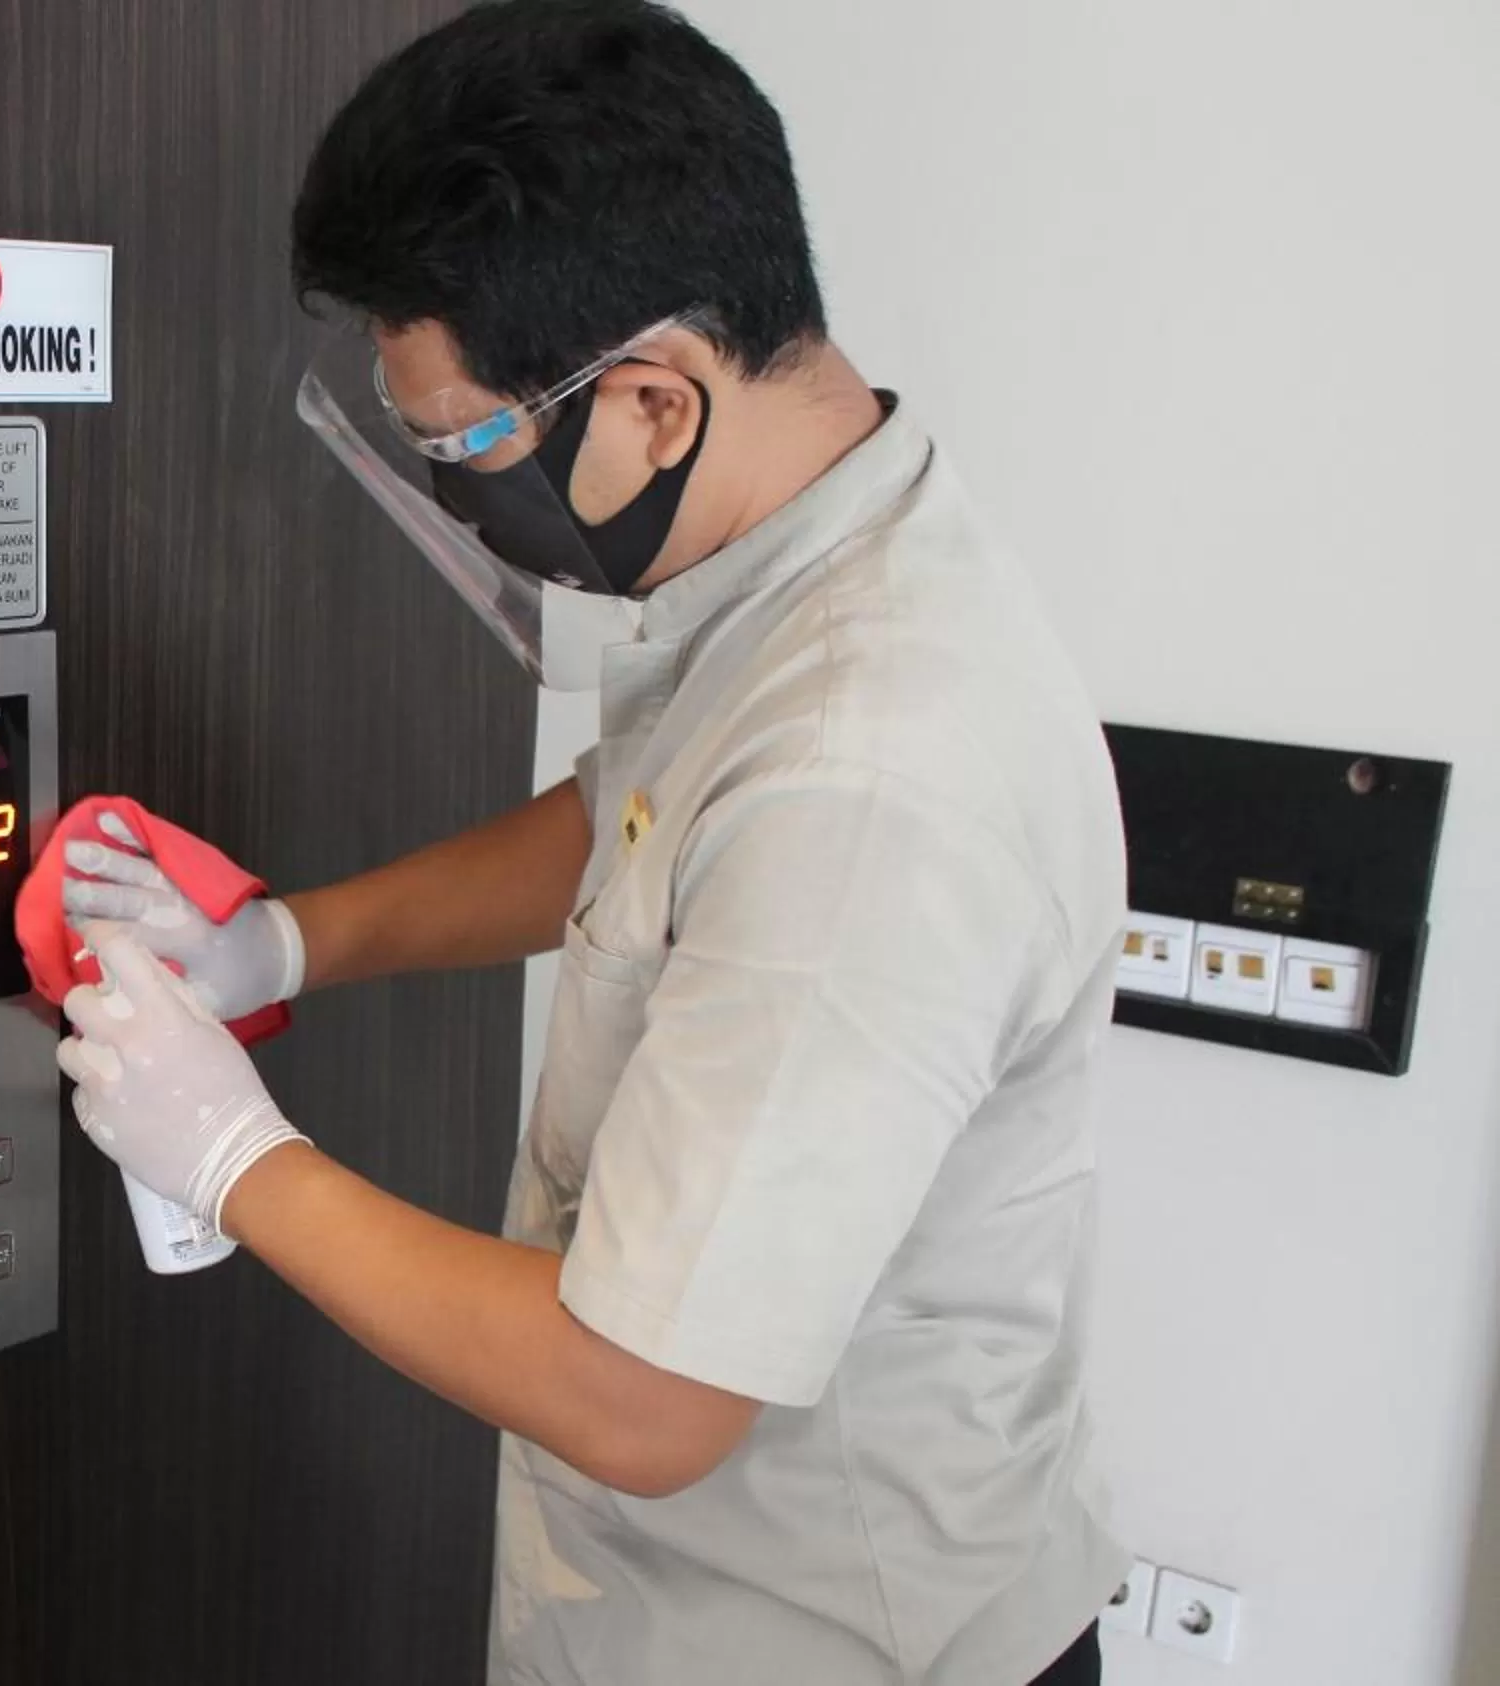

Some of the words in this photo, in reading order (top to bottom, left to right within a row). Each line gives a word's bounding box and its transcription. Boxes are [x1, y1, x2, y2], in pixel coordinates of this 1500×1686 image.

[5, 441, 28, 456] LIFT
[1, 461, 17, 474] OF
[4, 589, 30, 603] BUMI
